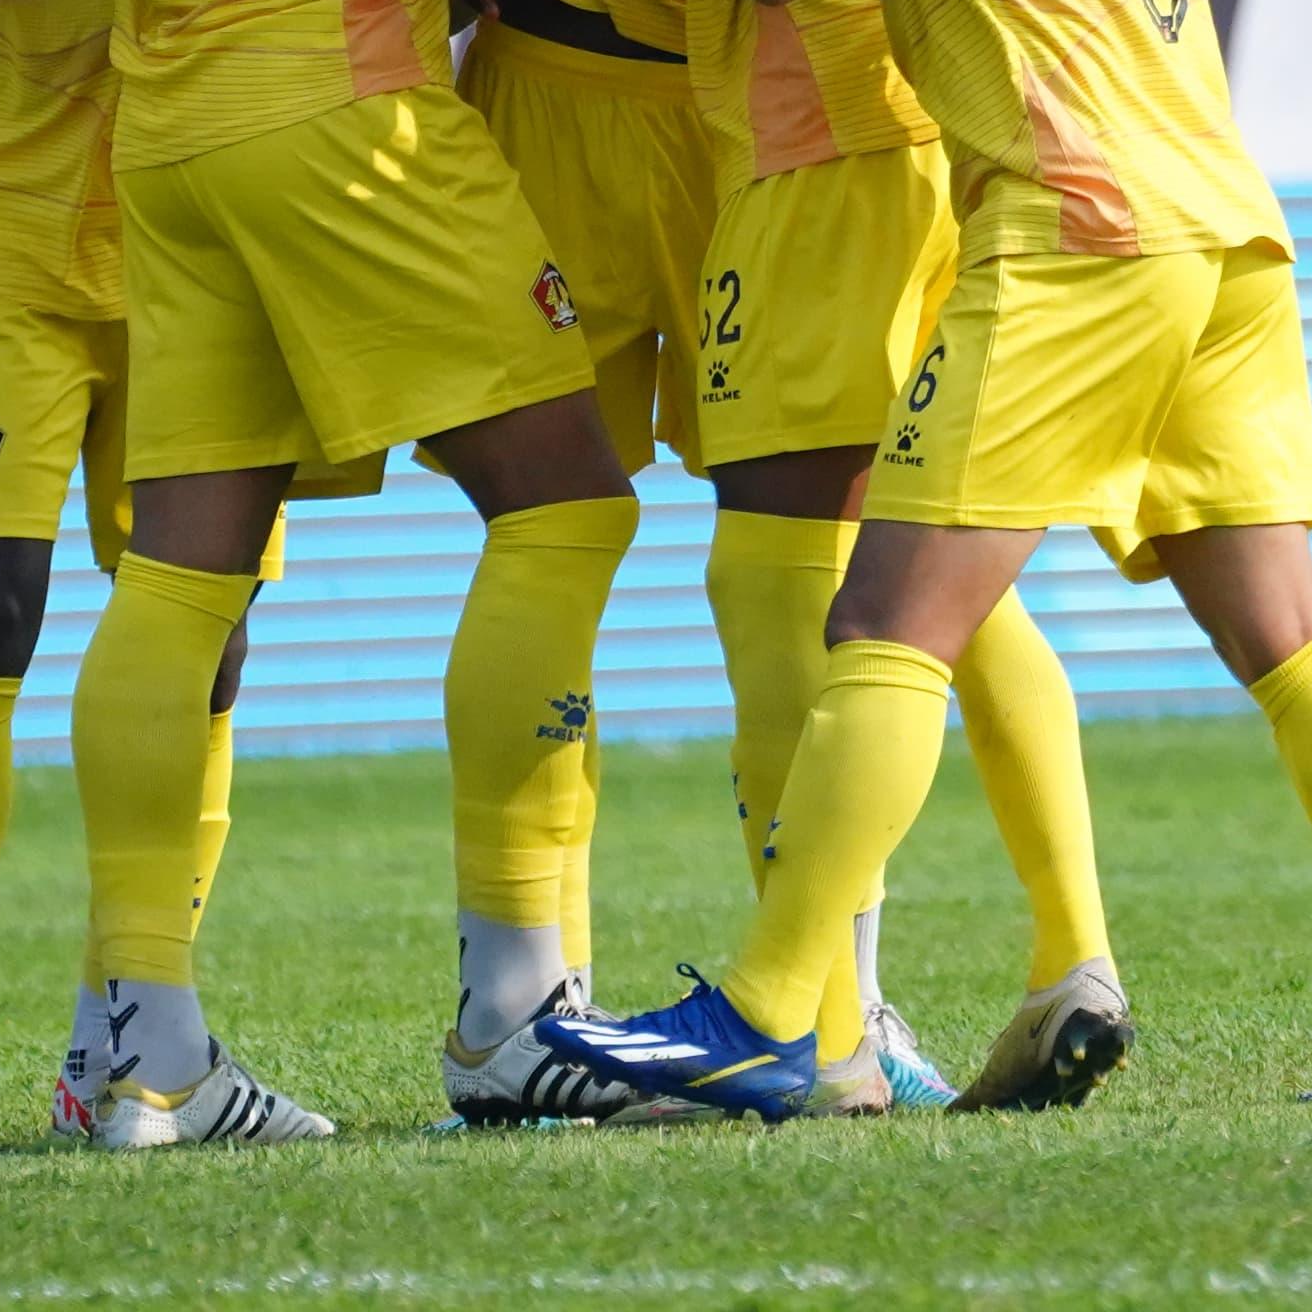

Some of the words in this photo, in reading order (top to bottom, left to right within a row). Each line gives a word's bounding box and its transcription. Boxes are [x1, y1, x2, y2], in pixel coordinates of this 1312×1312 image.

[908, 344, 945, 414] 6
[701, 389, 742, 405] KELME
[882, 452, 925, 468] KELME
